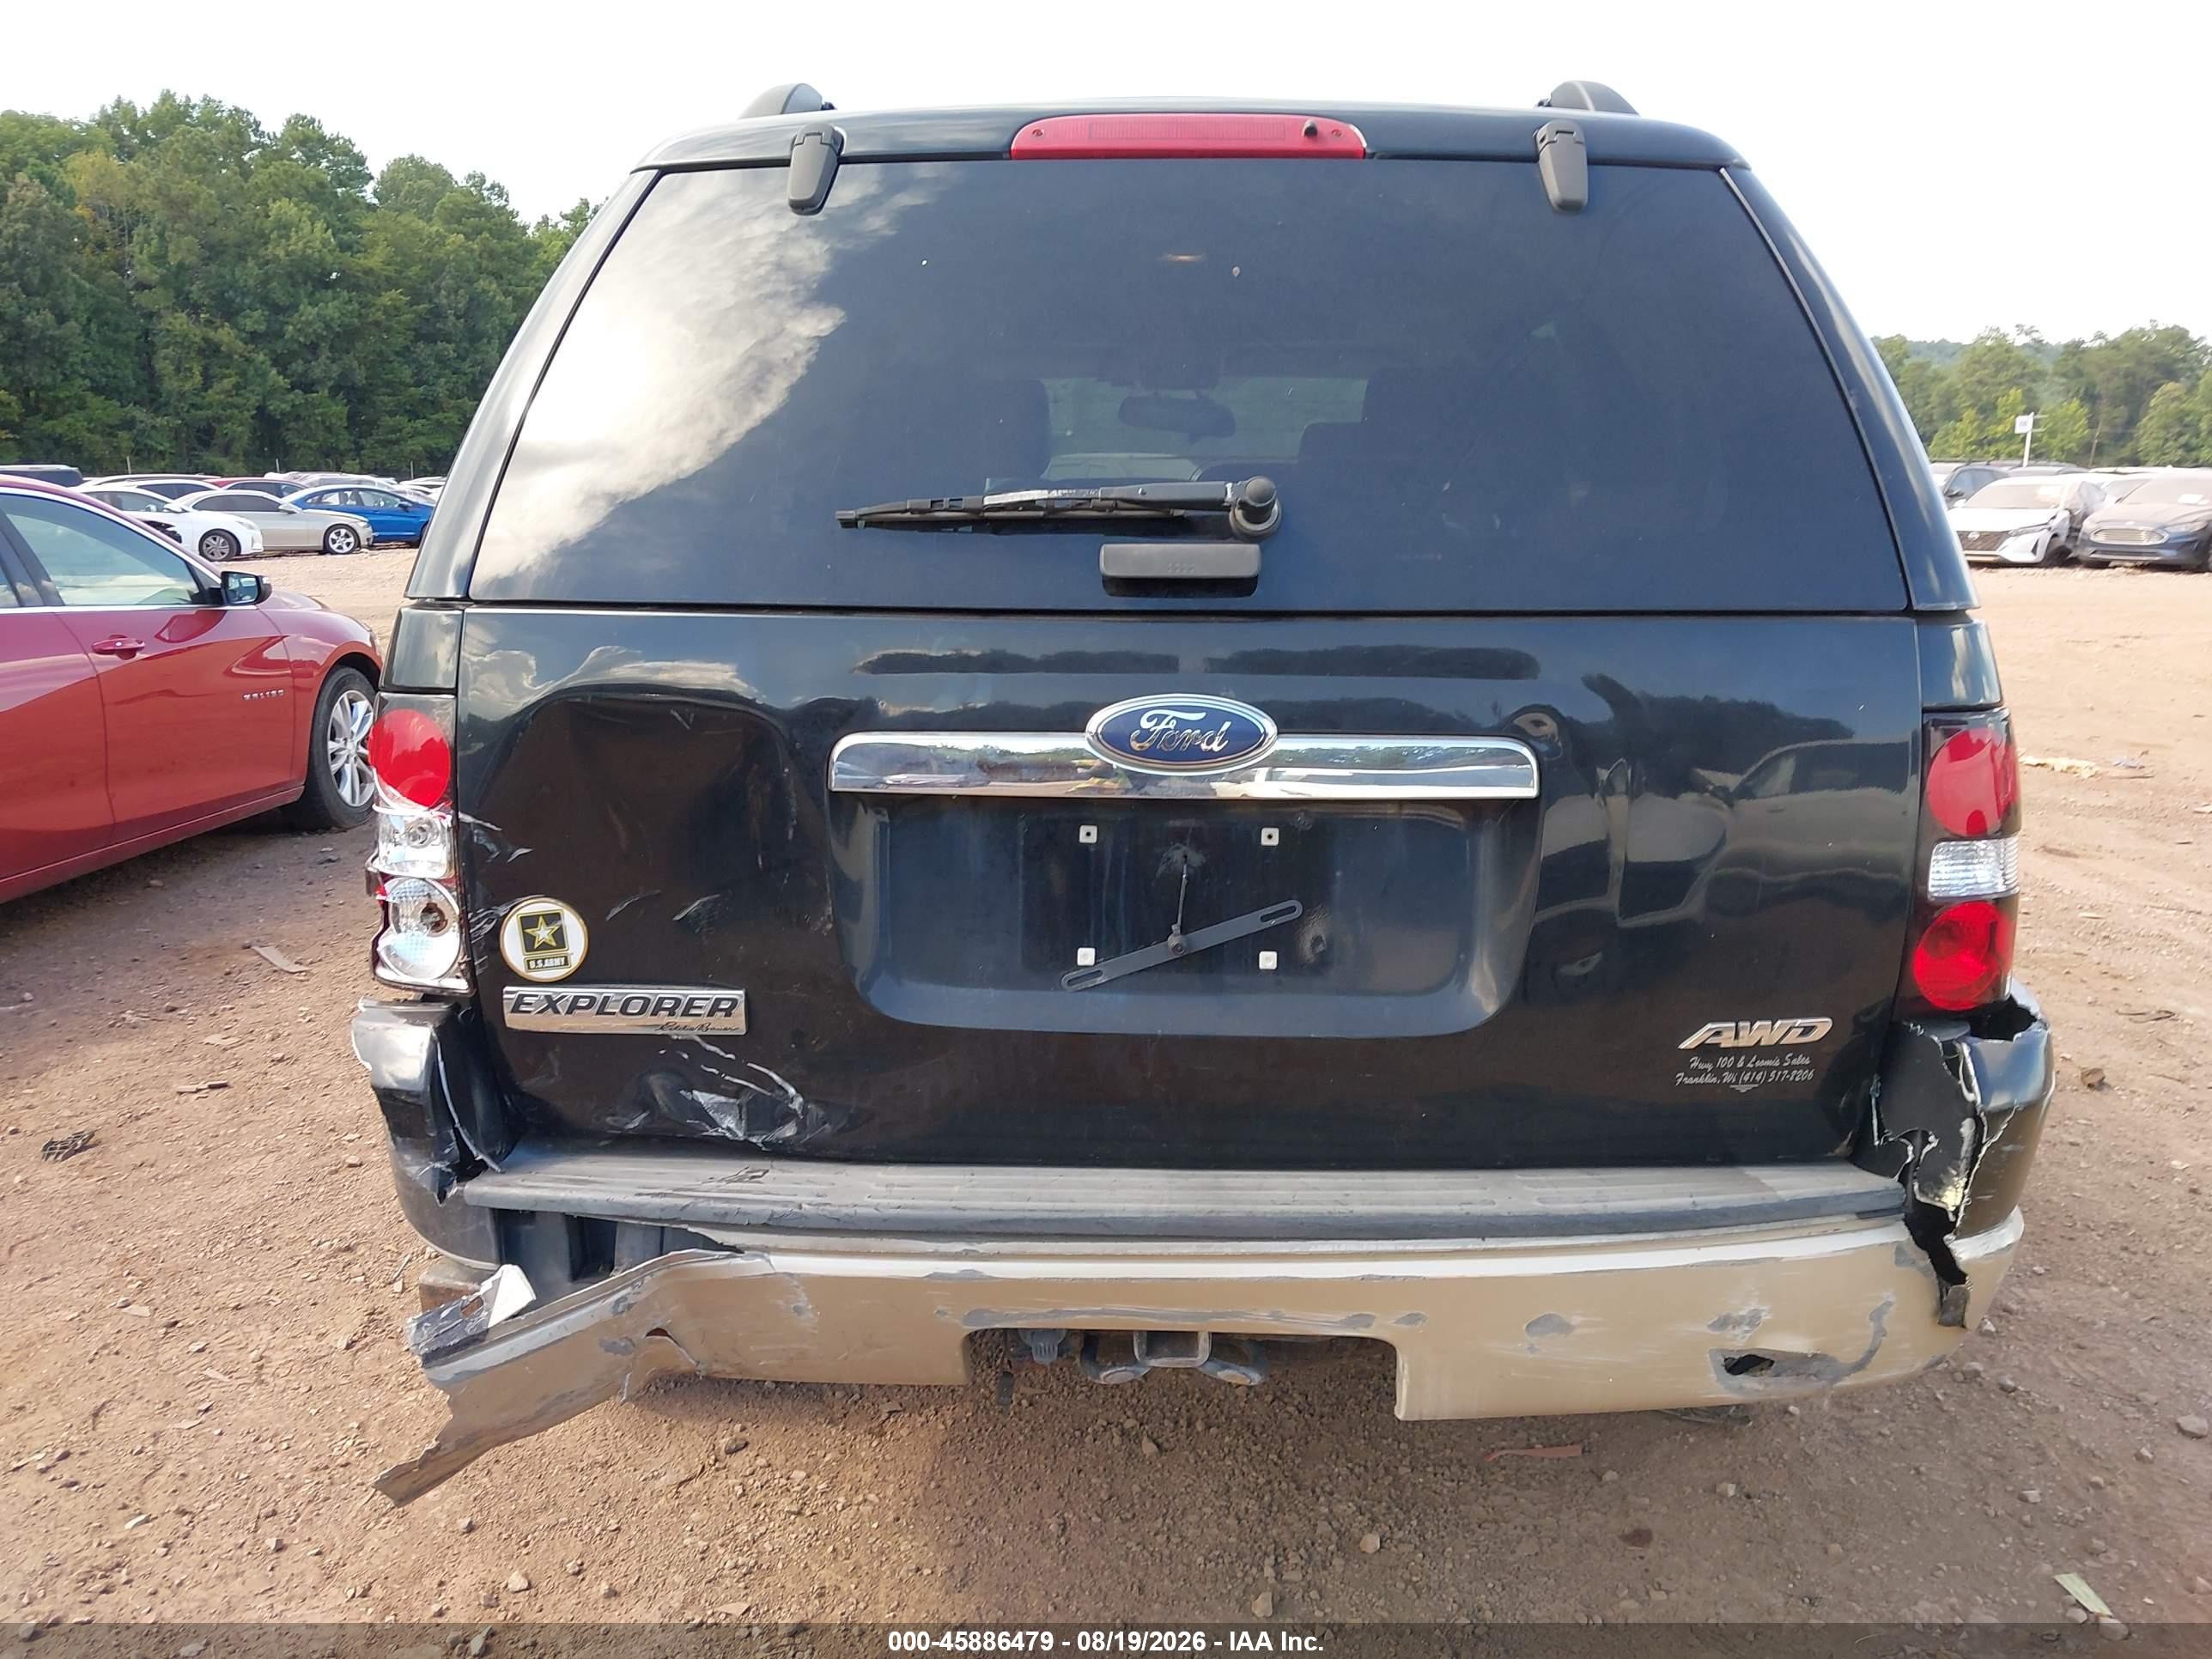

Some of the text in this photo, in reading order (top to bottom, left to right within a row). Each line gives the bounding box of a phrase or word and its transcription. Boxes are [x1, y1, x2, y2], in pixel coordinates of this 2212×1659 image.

[1129, 708, 1231, 753] Ford
[509, 992, 740, 1018] EXPLORER
[1677, 1017, 1833, 1050] AWD
[1689, 1056, 1713, 1072] Hwy
[1716, 1055, 1735, 1068] 100
[1783, 1052, 1811, 1066] Sales
[1739, 1070, 1767, 1085] (414)
